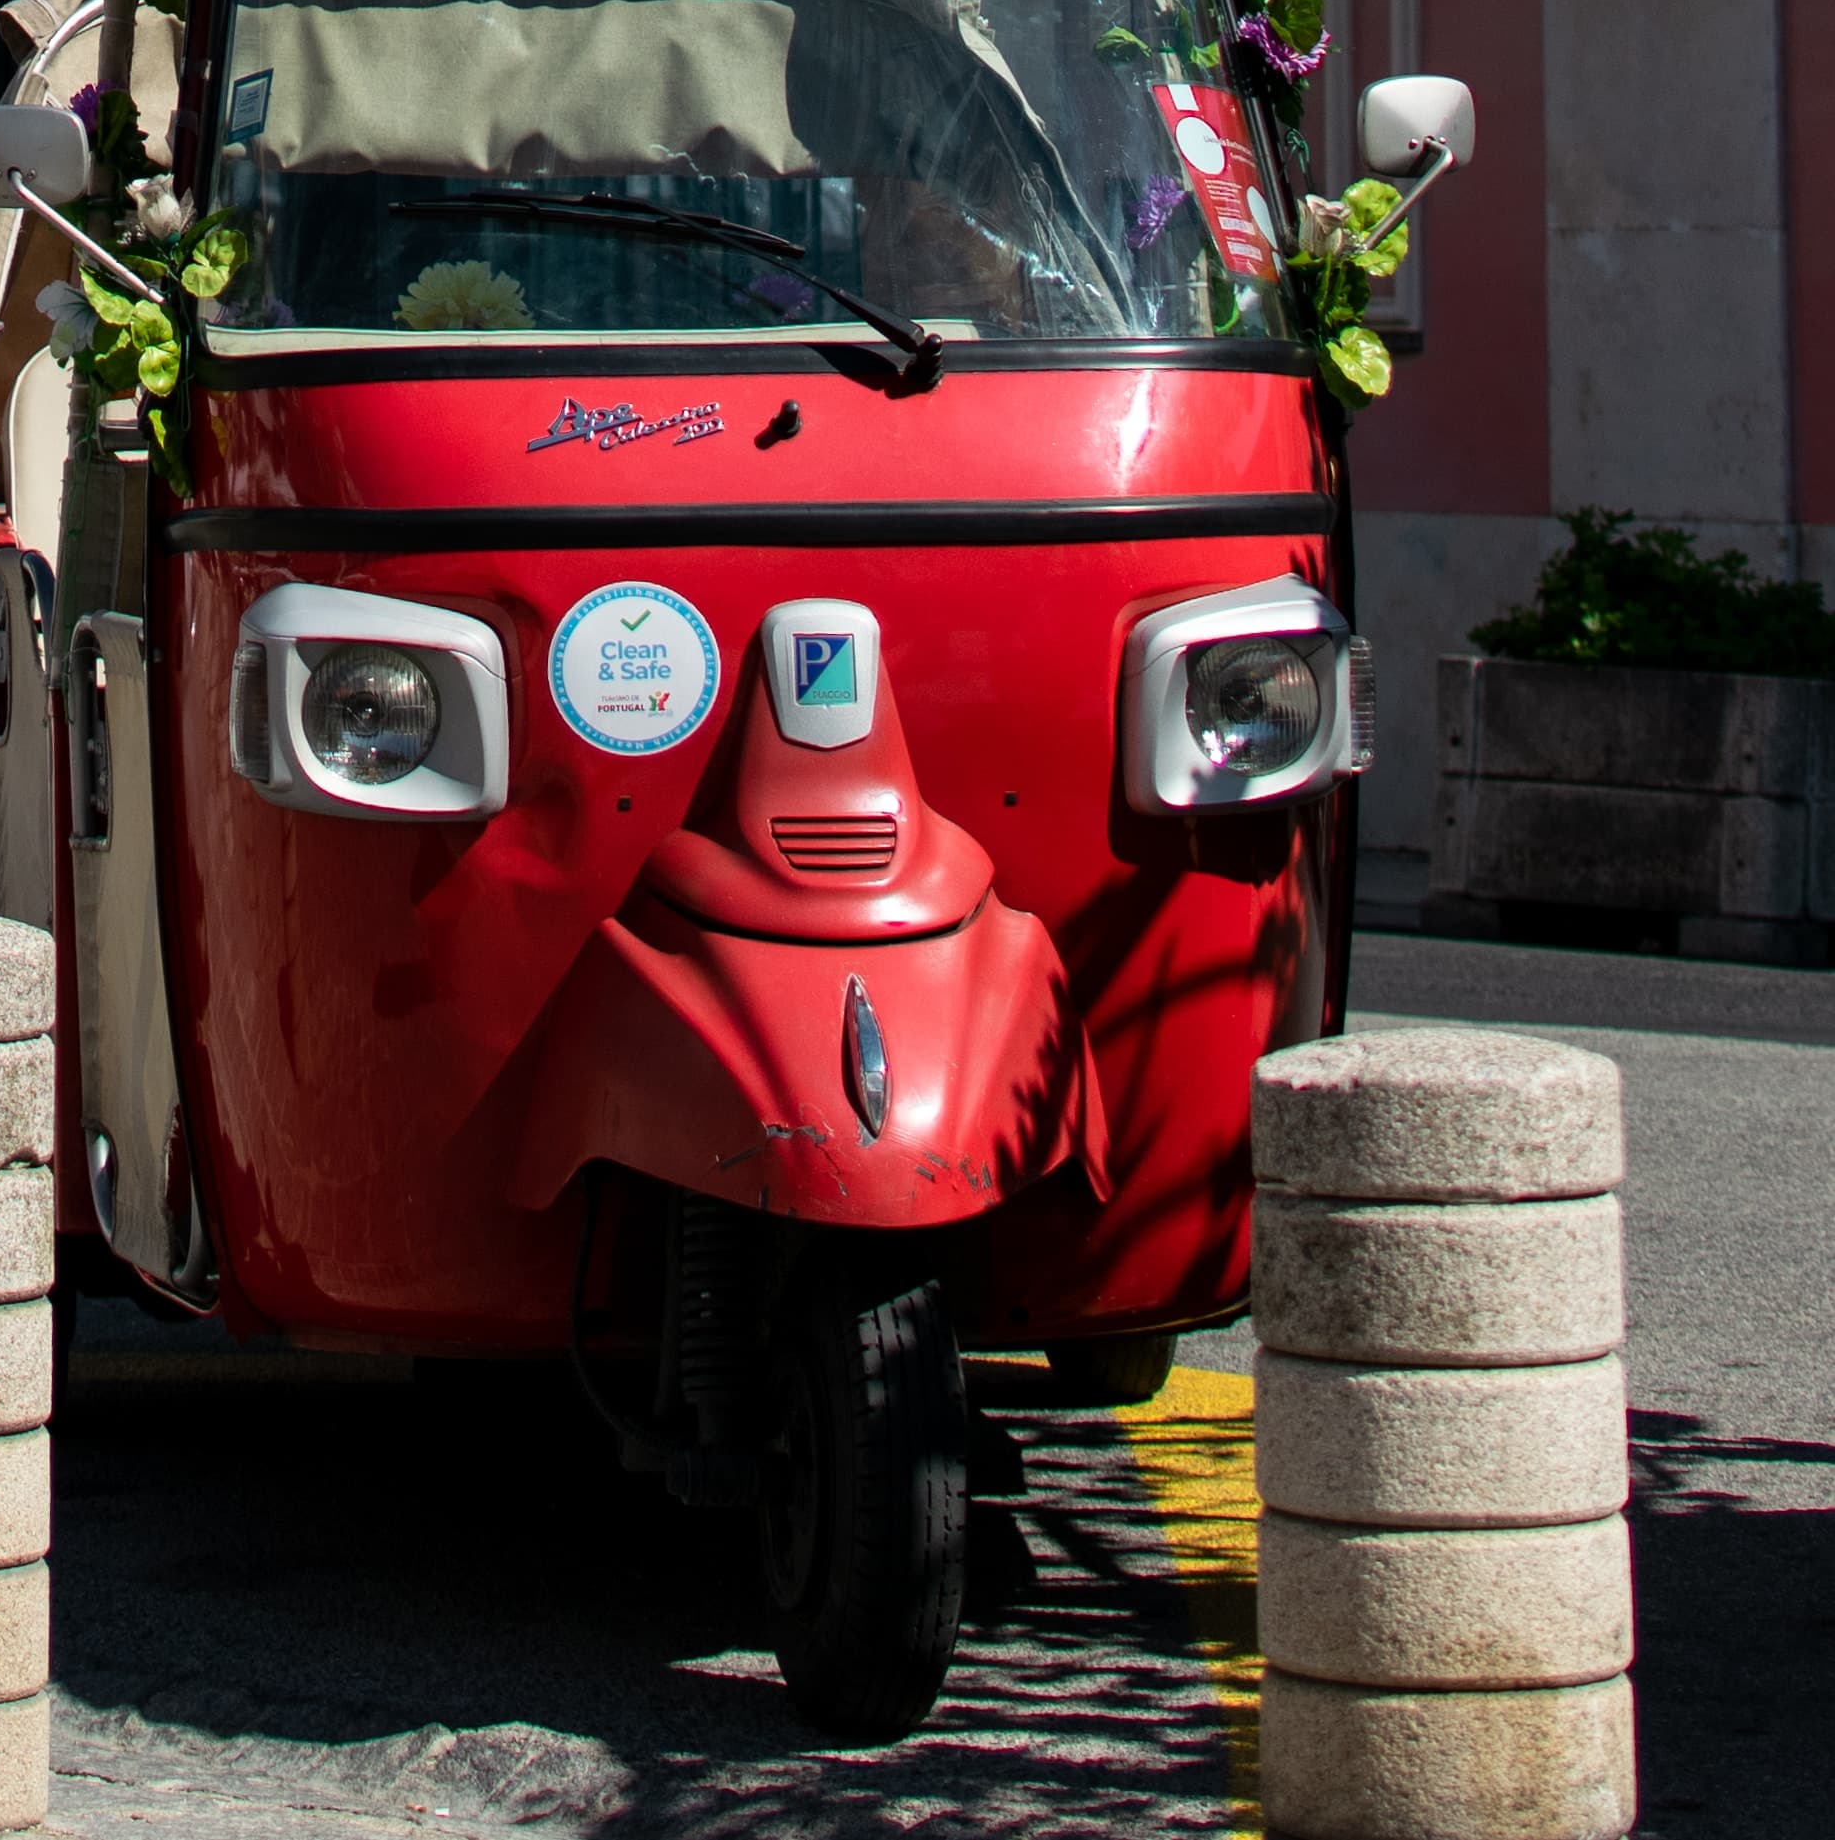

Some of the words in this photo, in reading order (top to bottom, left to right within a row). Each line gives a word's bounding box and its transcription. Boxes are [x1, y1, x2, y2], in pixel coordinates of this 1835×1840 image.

[528, 397, 642, 451] Ape
[600, 640, 667, 660] Clean
[598, 662, 614, 681] &
[620, 660, 672, 680] Safe
[597, 704, 646, 713] PORTUGAL
